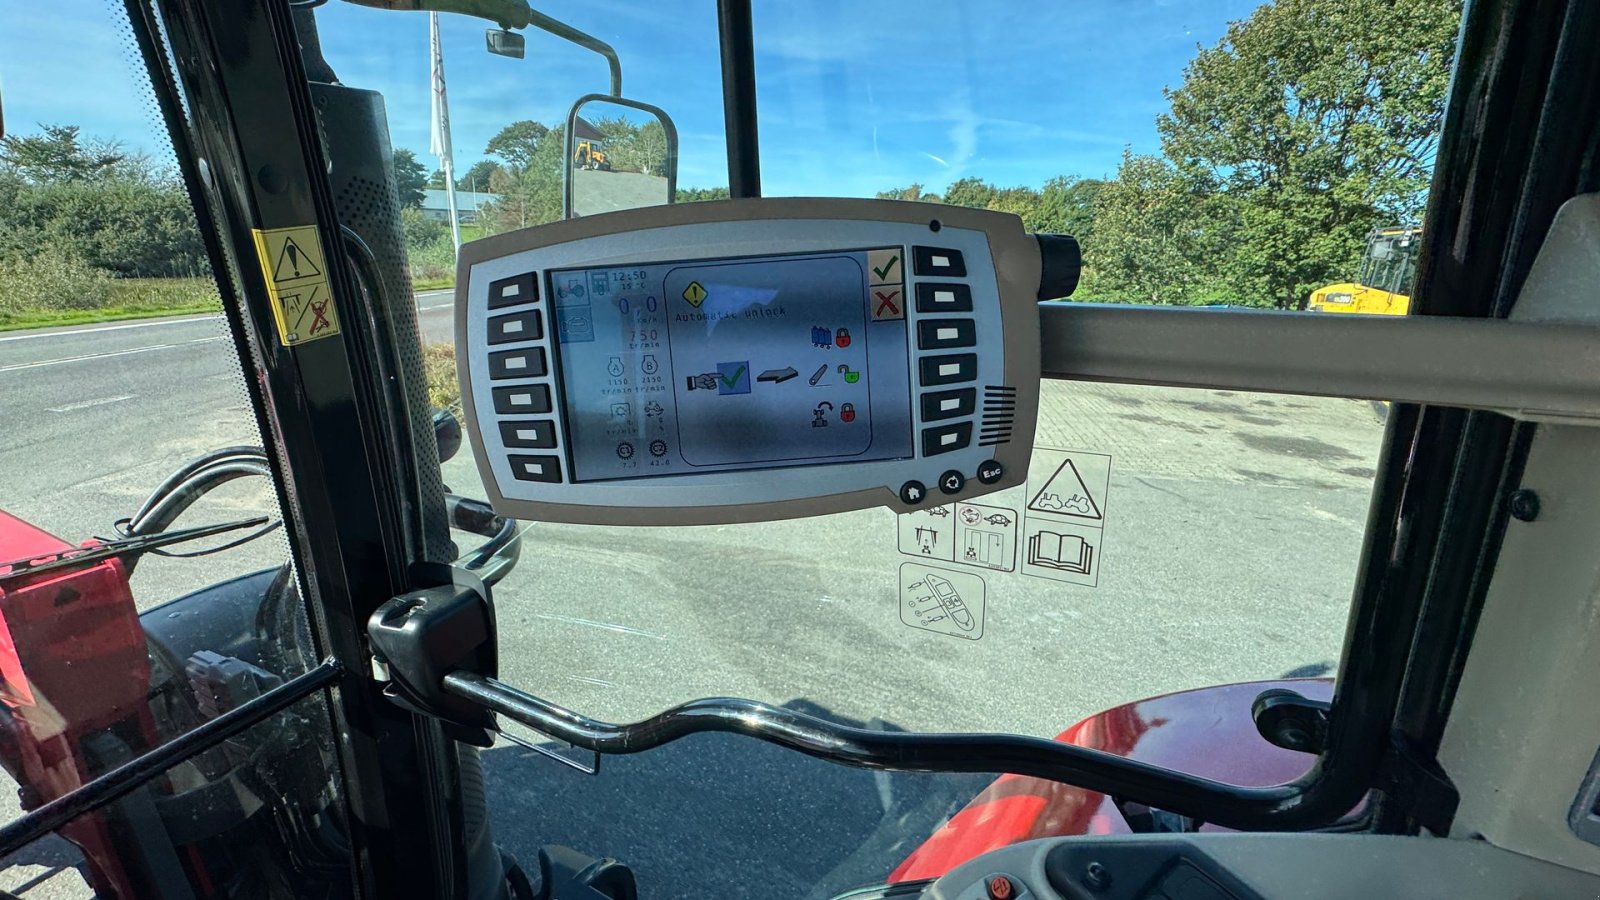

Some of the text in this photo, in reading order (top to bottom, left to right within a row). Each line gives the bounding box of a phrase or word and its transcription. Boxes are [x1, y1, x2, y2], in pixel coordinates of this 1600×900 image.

[612, 270, 647, 282] 12:50
[676, 311, 737, 322] Automatic
[630, 329, 658, 342] 750
[646, 361, 653, 371] B
[635, 385, 666, 393] tr/min
[983, 468, 1001, 479] Esc
